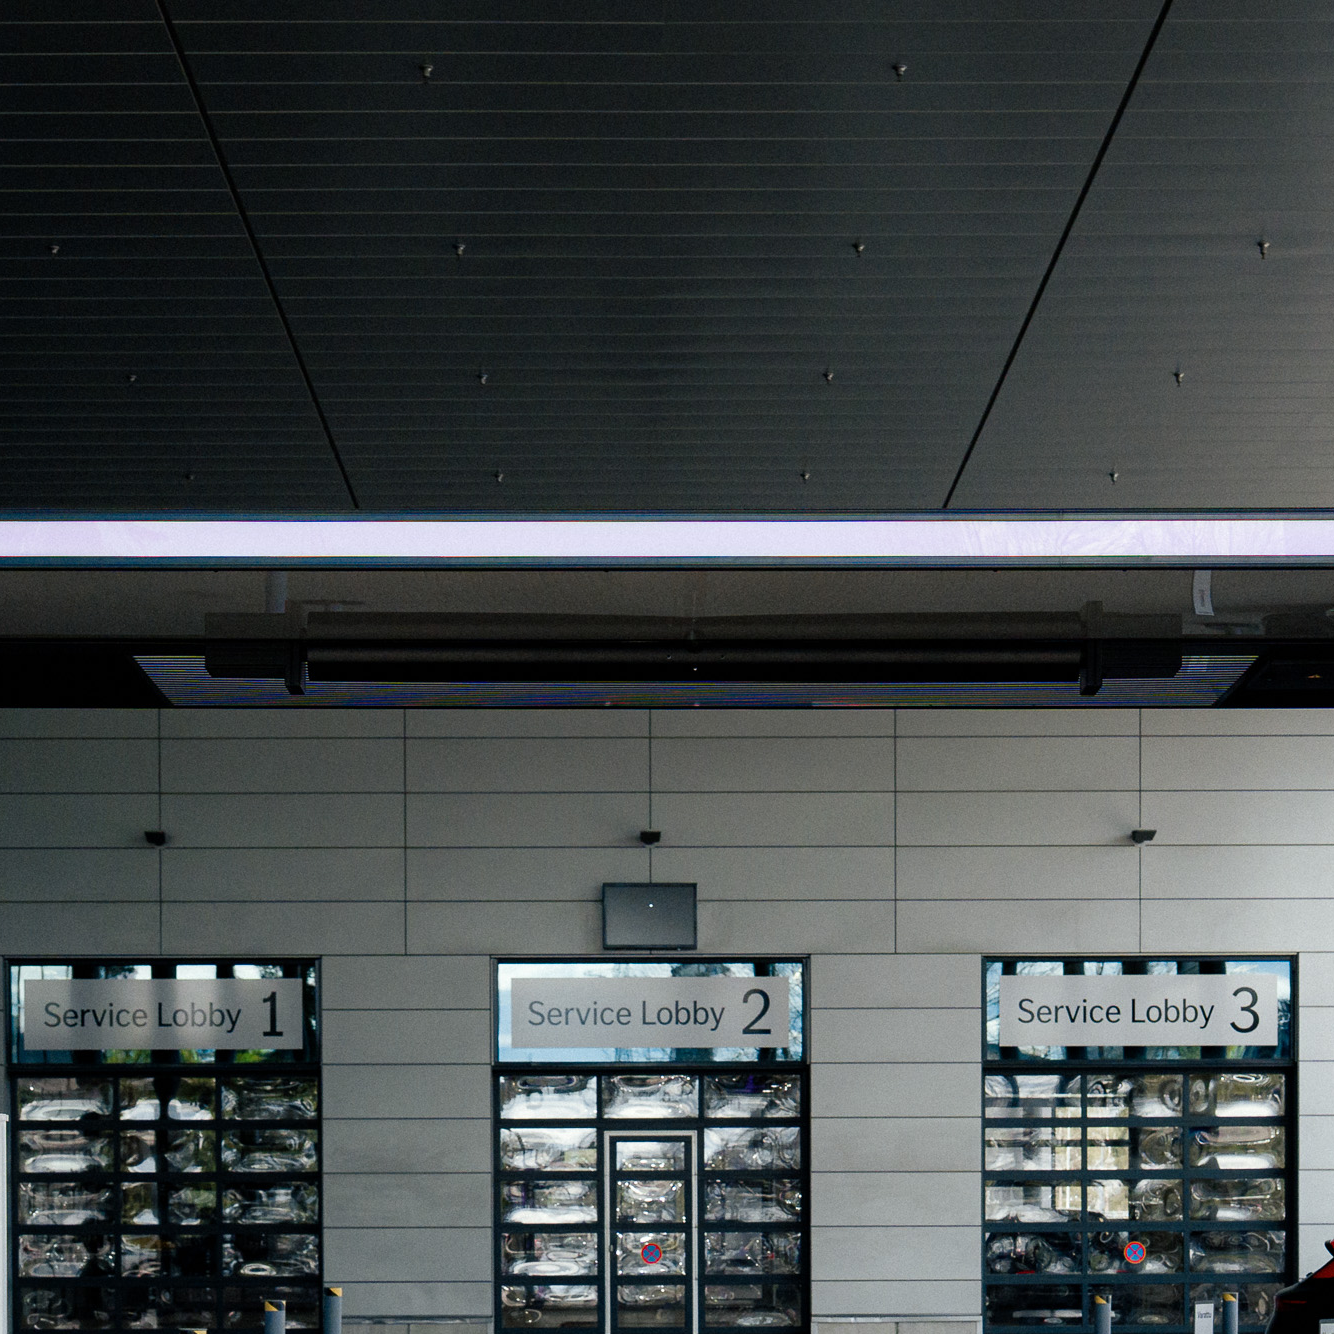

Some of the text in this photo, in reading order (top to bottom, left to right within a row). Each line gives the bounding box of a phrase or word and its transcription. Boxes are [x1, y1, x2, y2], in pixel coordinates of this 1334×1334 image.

[43, 991, 284, 1037] Service Lobby 1
[527, 988, 772, 1035] Service Lobby 2
[1017, 986, 1260, 1033] Service Lobby 3
